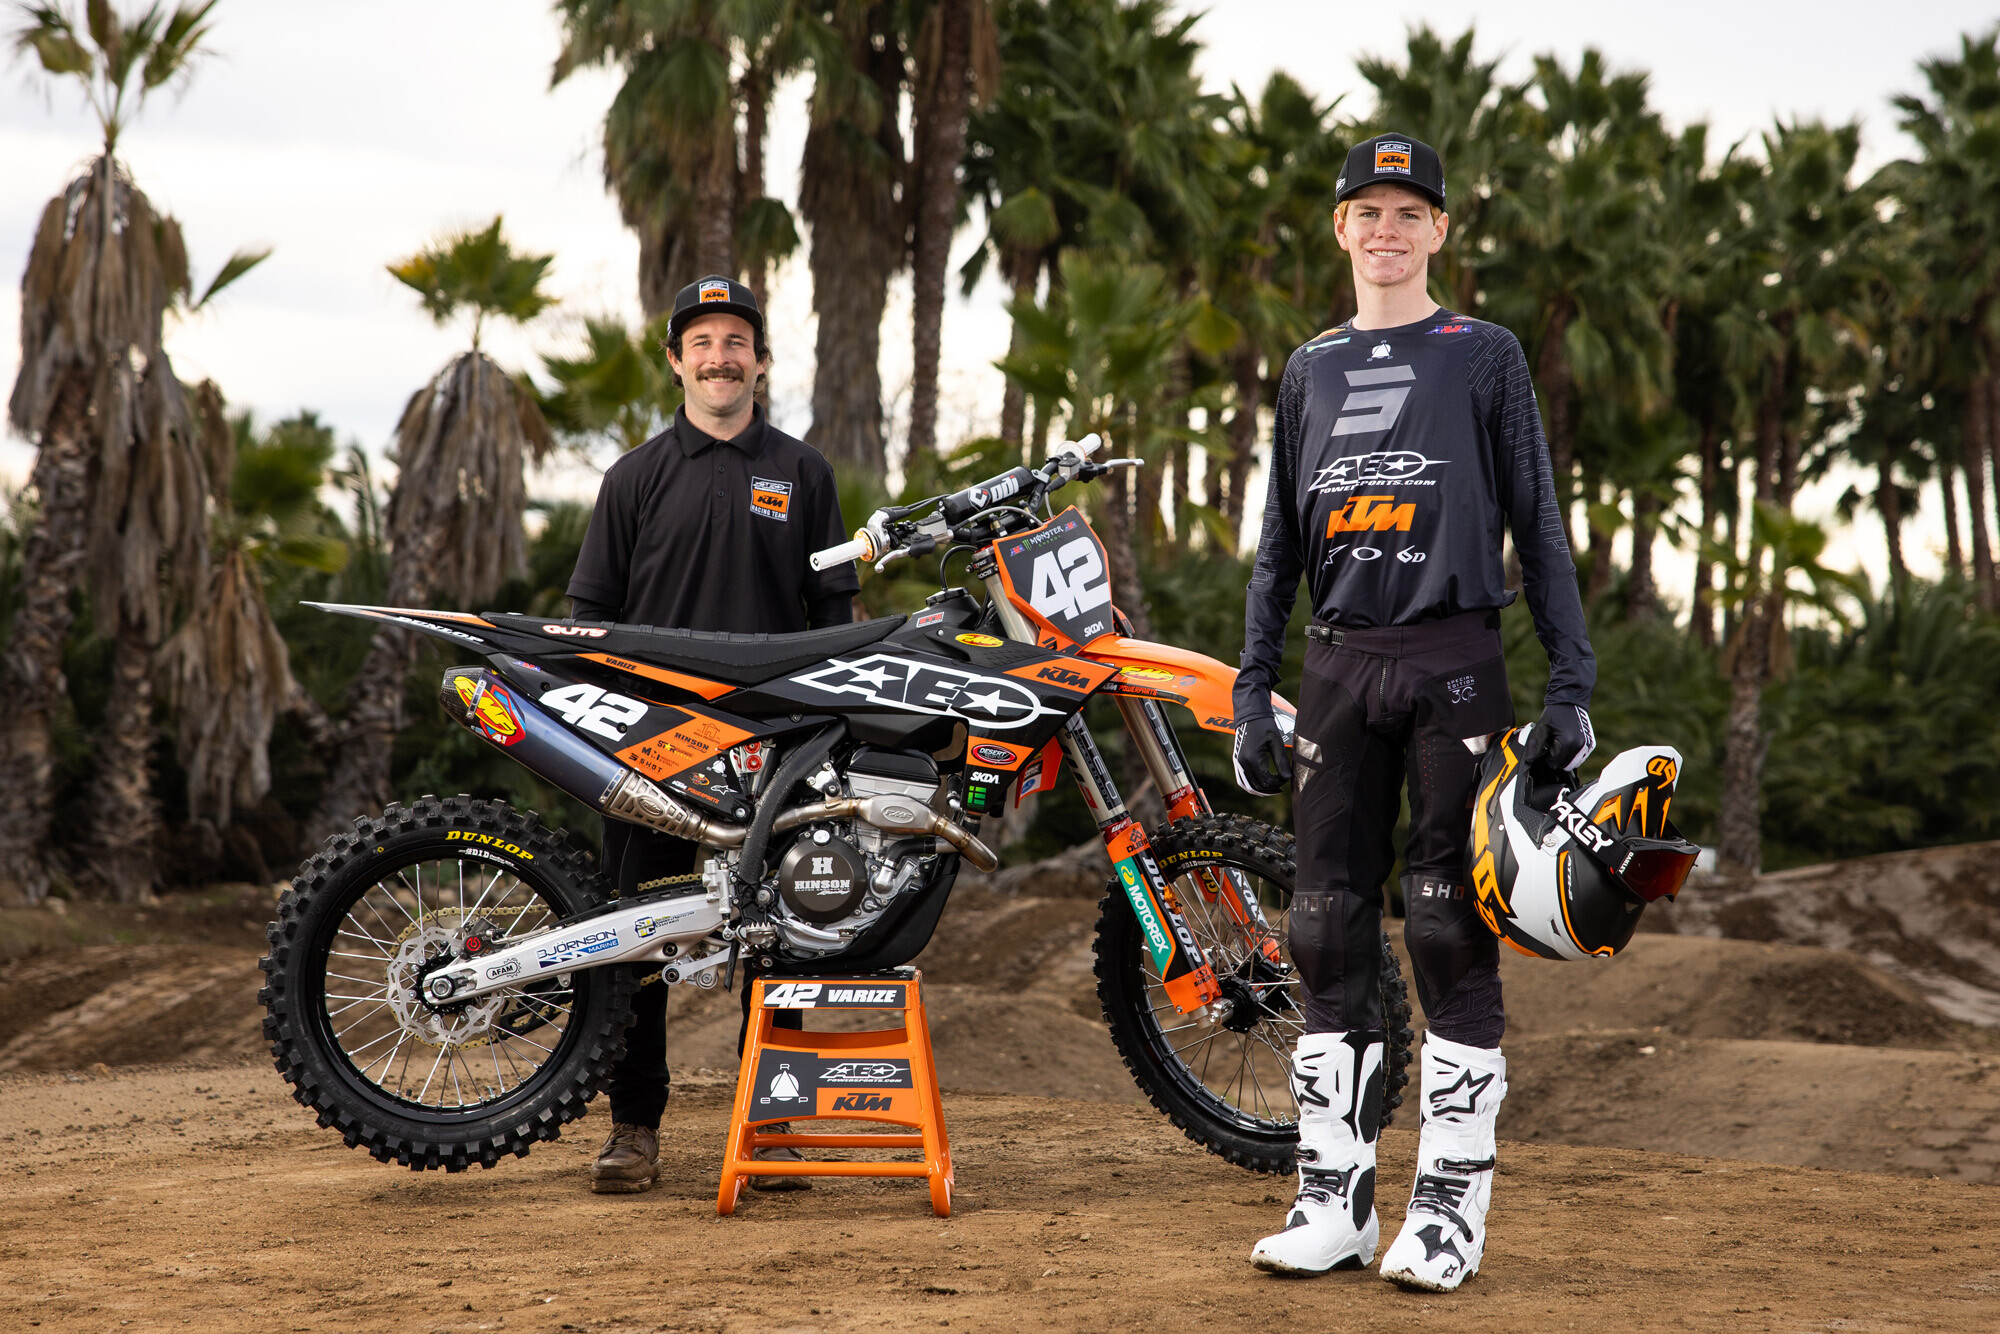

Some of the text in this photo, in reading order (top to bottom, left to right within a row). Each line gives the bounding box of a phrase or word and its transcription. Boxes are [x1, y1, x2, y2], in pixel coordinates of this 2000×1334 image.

[1381, 155, 1405, 164] KTM
[757, 495, 783, 507] KTM
[751, 505, 787, 519] RACING TEAM
[1326, 495, 1417, 539] KTM
[1029, 525, 1064, 545] MONSTER
[1029, 536, 1112, 620] 42
[393, 616, 486, 644] DUNLOP
[543, 625, 608, 638] GUTS
[1083, 620, 1105, 638] SKDA
[605, 657, 638, 672] VARIZE
[1038, 666, 1091, 690] KTM
[1446, 674, 1474, 686] SPECIAL
[1118, 684, 1158, 697] POWERPARTS
[538, 683, 650, 743] 42
[674, 732, 710, 751] HINSON
[978, 747, 1007, 759] DESERT
[638, 757, 663, 774] SHOT
[969, 771, 1000, 784] SKDA
[445, 830, 535, 861] DUNLOP
[812, 856, 834, 875] H
[1157, 850, 1223, 870] DUNLOP
[1617, 850, 1635, 875] OAKLEY
[794, 879, 850, 890] HINSON
[1421, 881, 1465, 899] SHO
[1142, 856, 1202, 964] DULOP
[1128, 884, 1170, 955] MOTOREX
[537, 927, 617, 960] BJÖRNSON
[588, 939, 618, 954] MARINE
[491, 964, 514, 977] AFAM
[764, 984, 898, 1008] 42 VARIZE
[818, 1063, 910, 1079] AEO
[832, 1093, 893, 1111] KTM
